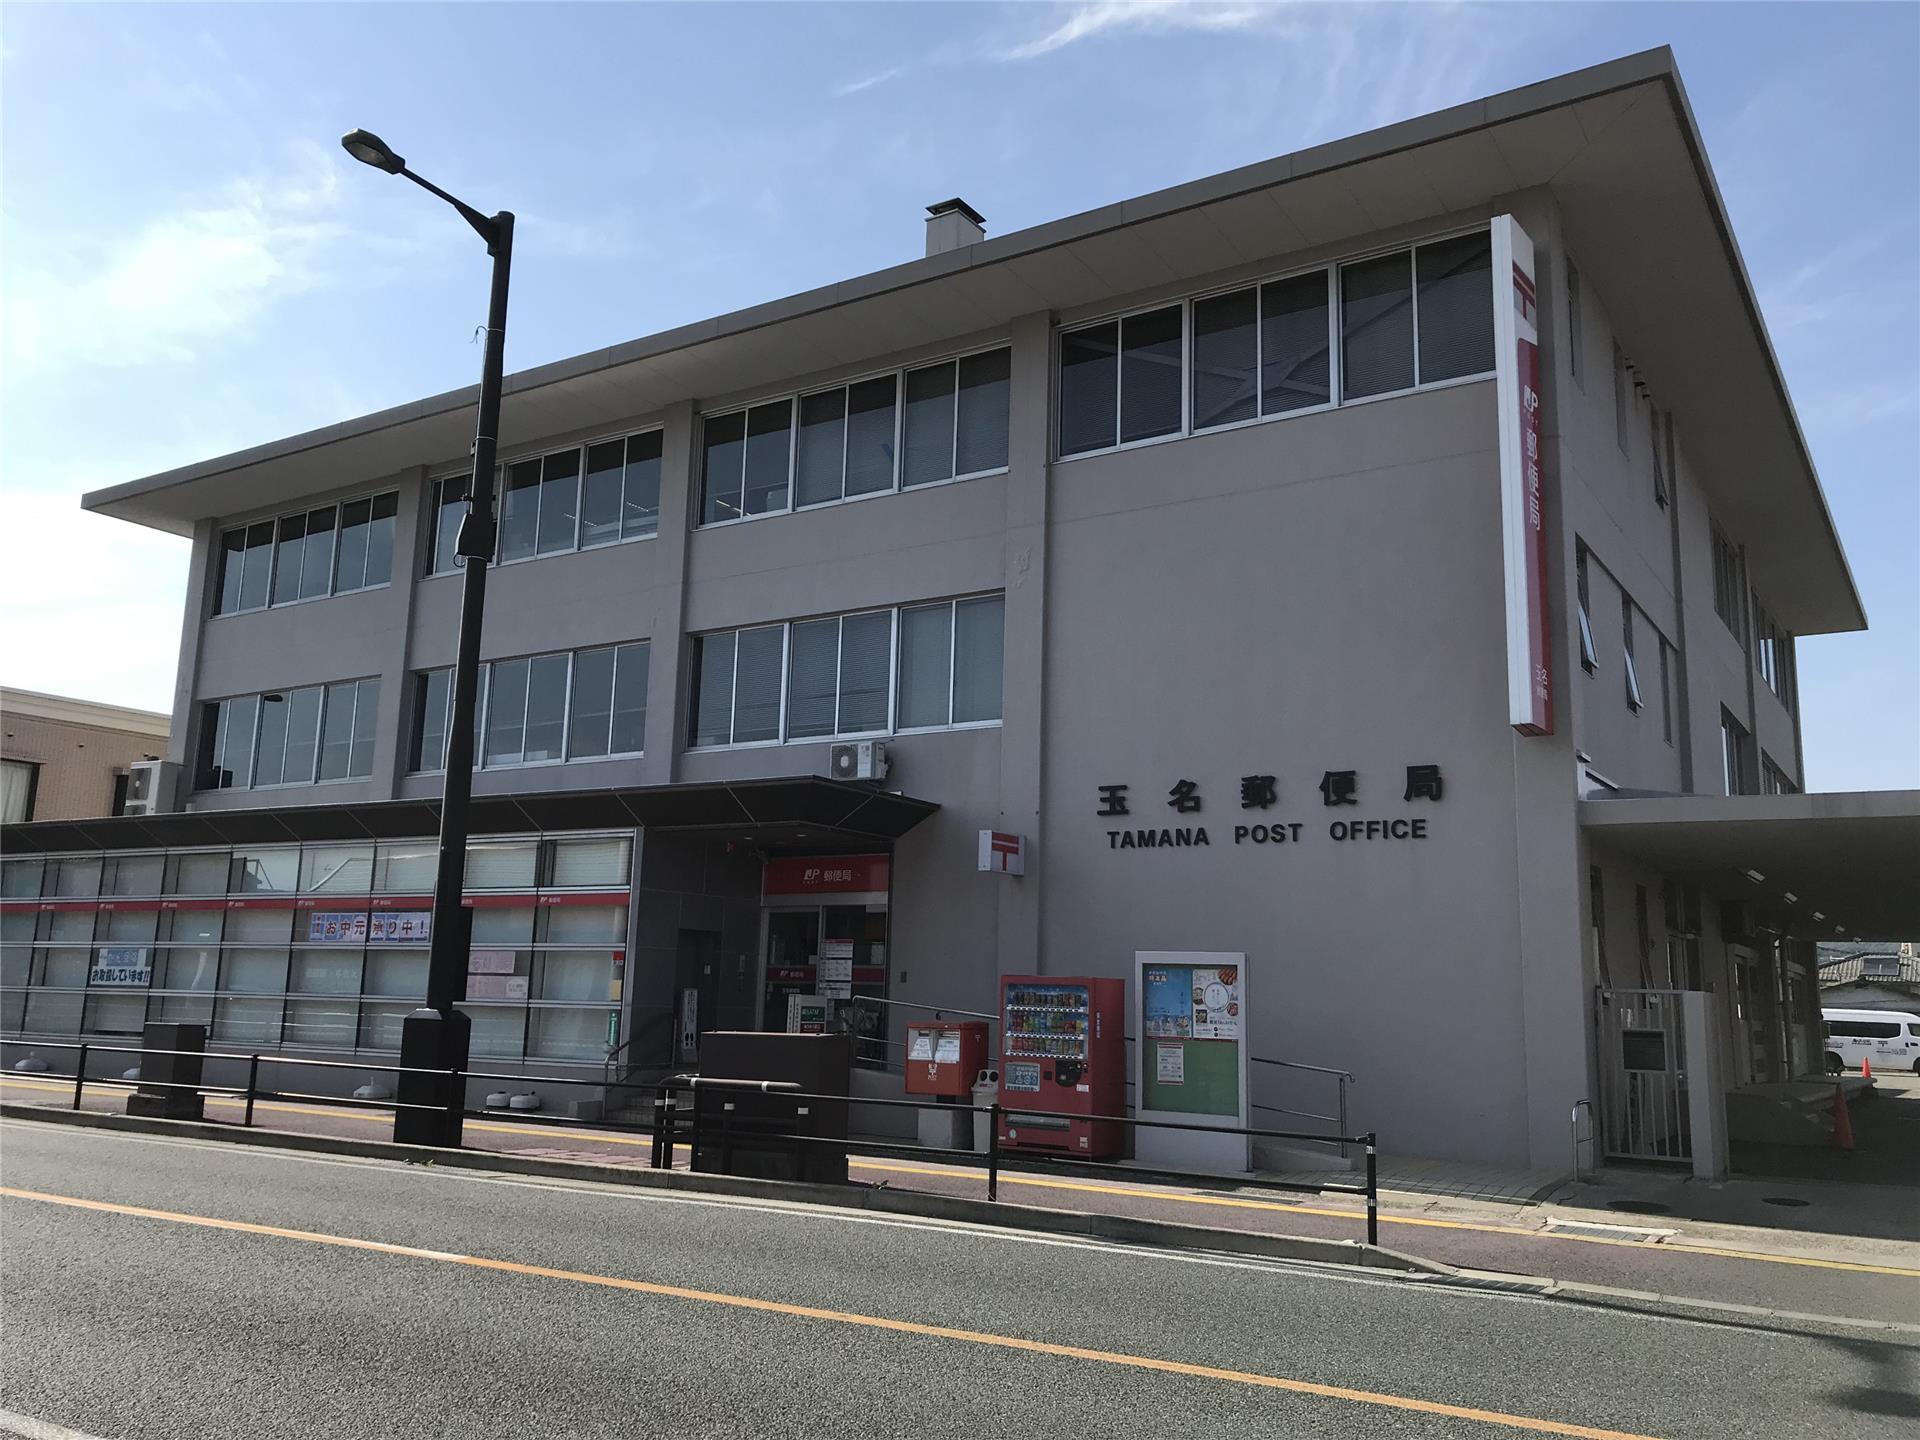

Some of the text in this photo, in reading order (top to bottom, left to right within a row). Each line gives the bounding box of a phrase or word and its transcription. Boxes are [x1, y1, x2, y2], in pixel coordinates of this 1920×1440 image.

[1526, 427, 1540, 531] 郵便局
[1097, 765, 1443, 815] 玉名郵便局
[1107, 819, 1427, 849] TAMANA POST OFFICE
[823, 869, 852, 881] 郵便局
